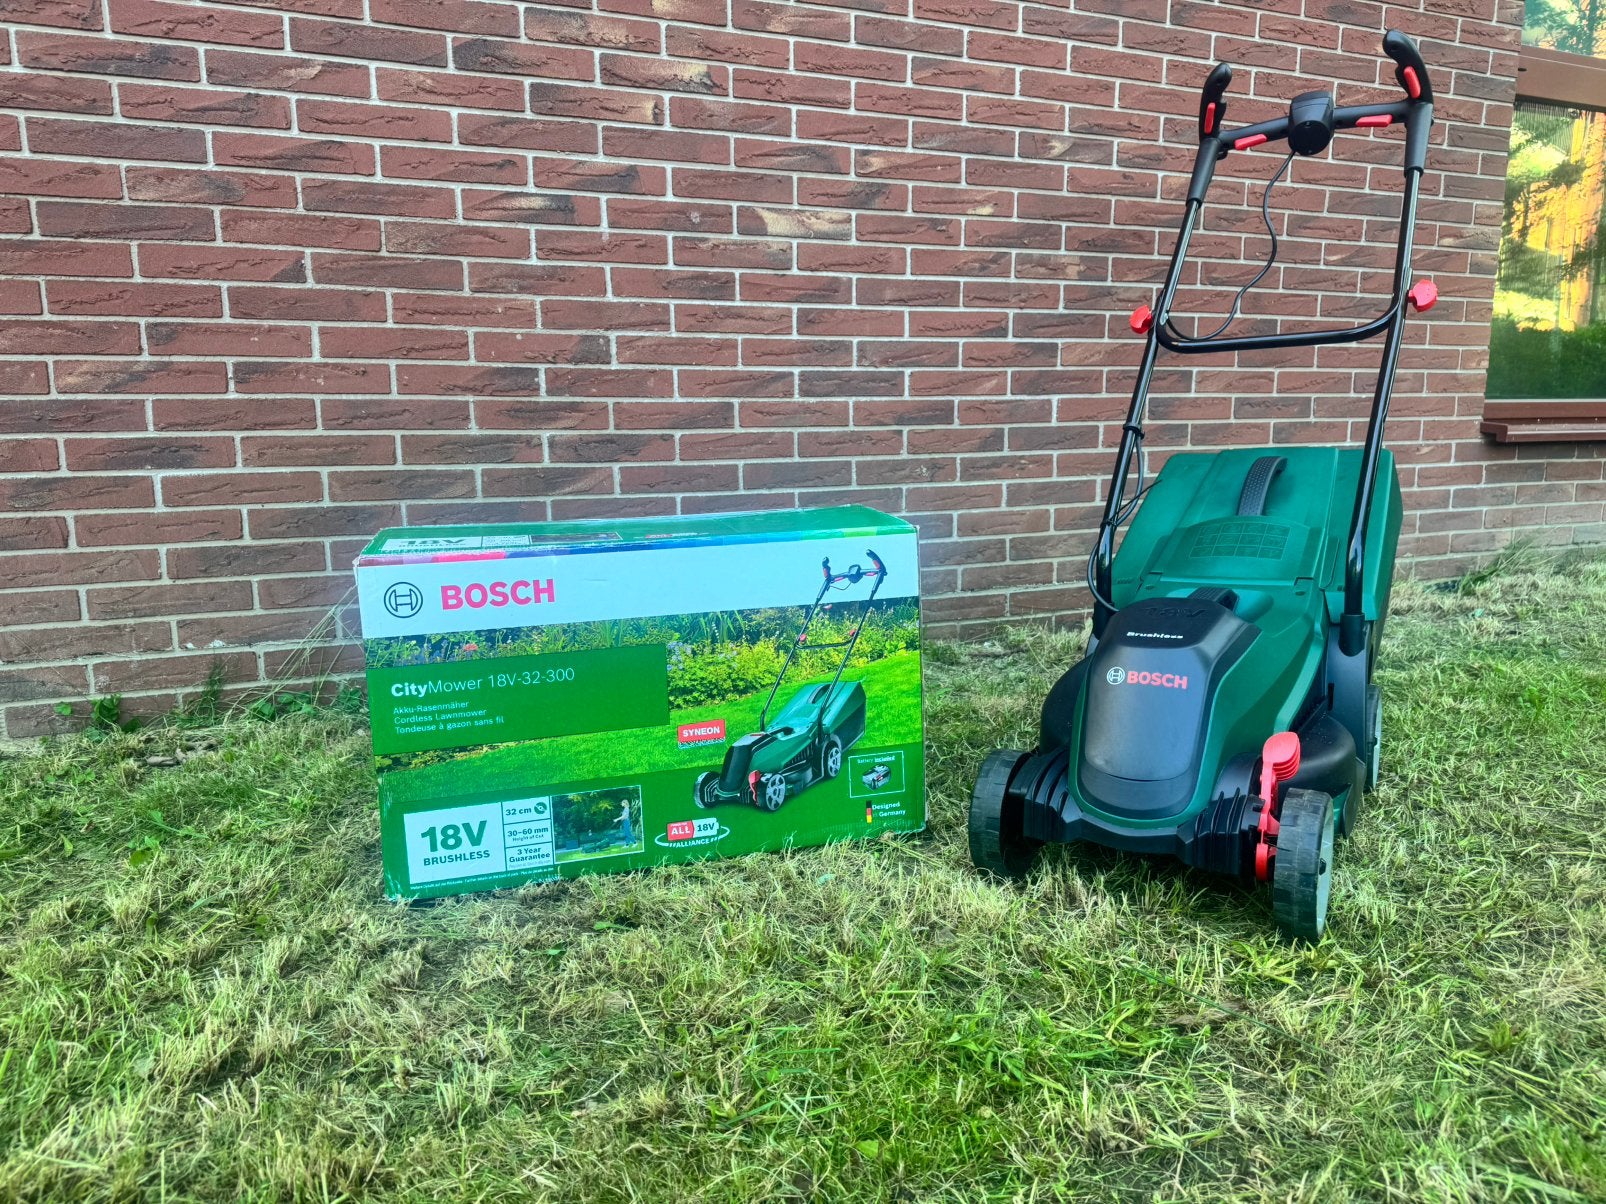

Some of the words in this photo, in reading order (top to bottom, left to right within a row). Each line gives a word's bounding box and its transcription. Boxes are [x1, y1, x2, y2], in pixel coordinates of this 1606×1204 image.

[440, 578, 555, 611] BOSCH
[1126, 631, 1184, 639] Brushless
[391, 677, 483, 698] CityMower
[488, 667, 575, 688] 18V-32-300
[1127, 671, 1188, 690] BOSCH
[393, 701, 470, 715] Akku-Rasenmäher
[394, 715, 433, 725] Cordless
[435, 709, 487, 721] Lawnmower
[394, 724, 437, 735] Tondeuse
[439, 721, 444, 730] à
[446, 720, 472, 731] gazon
[474, 717, 494, 726] sans
[495, 715, 505, 724] fil
[682, 726, 721, 737] SYNEON
[505, 808, 518, 816] 32
[518, 807, 532, 815] cm
[872, 801, 901, 810] Designed
[534, 826, 549, 834] mm
[671, 825, 690, 835] ALL
[697, 822, 715, 832] 18V
[420, 820, 488, 853] 18V
[676, 838, 710, 848] ALLIANCE
[423, 849, 491, 866] BRUSHLESS
[508, 852, 551, 863] Guarantee
[517, 848, 523, 856] 3
[523, 847, 542, 855] Year
